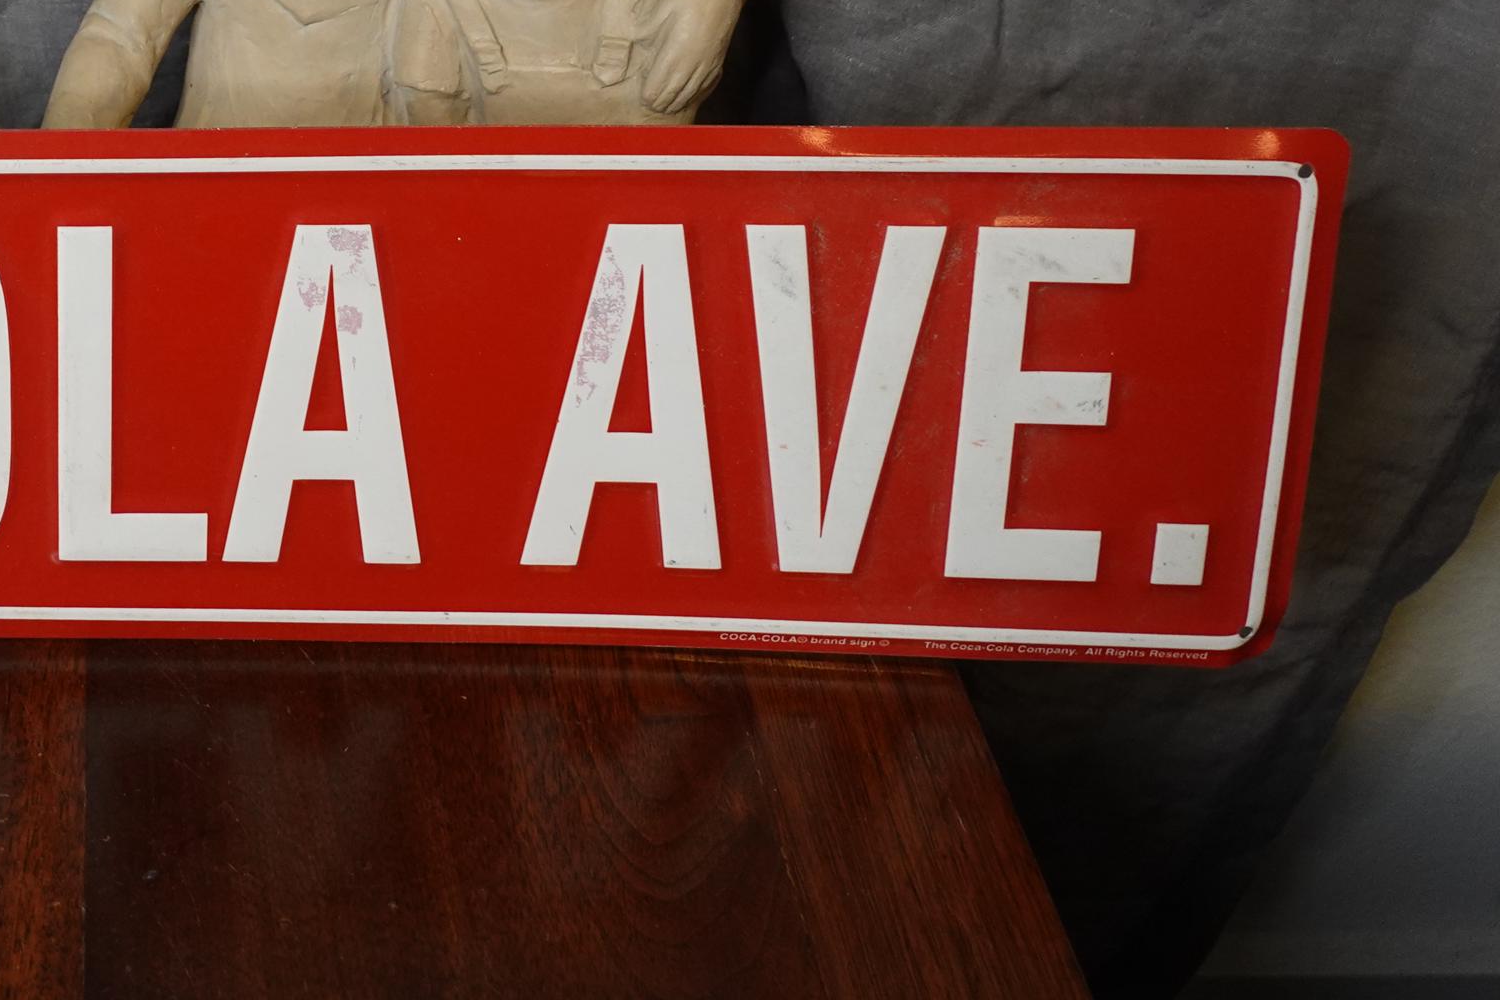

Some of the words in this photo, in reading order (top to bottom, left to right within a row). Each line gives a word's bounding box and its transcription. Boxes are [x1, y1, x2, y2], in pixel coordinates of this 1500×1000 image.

[519, 222, 1210, 586] AVE.
[810, 636, 846, 646] brand
[849, 638, 876, 648] sign
[924, 641, 947, 650] The
[950, 642, 1014, 653] Coca-Cola
[1017, 645, 1078, 656] Company.
[1085, 647, 1101, 656] All
[1105, 648, 1145, 659] Rights
[1149, 649, 1209, 660] Reserved
